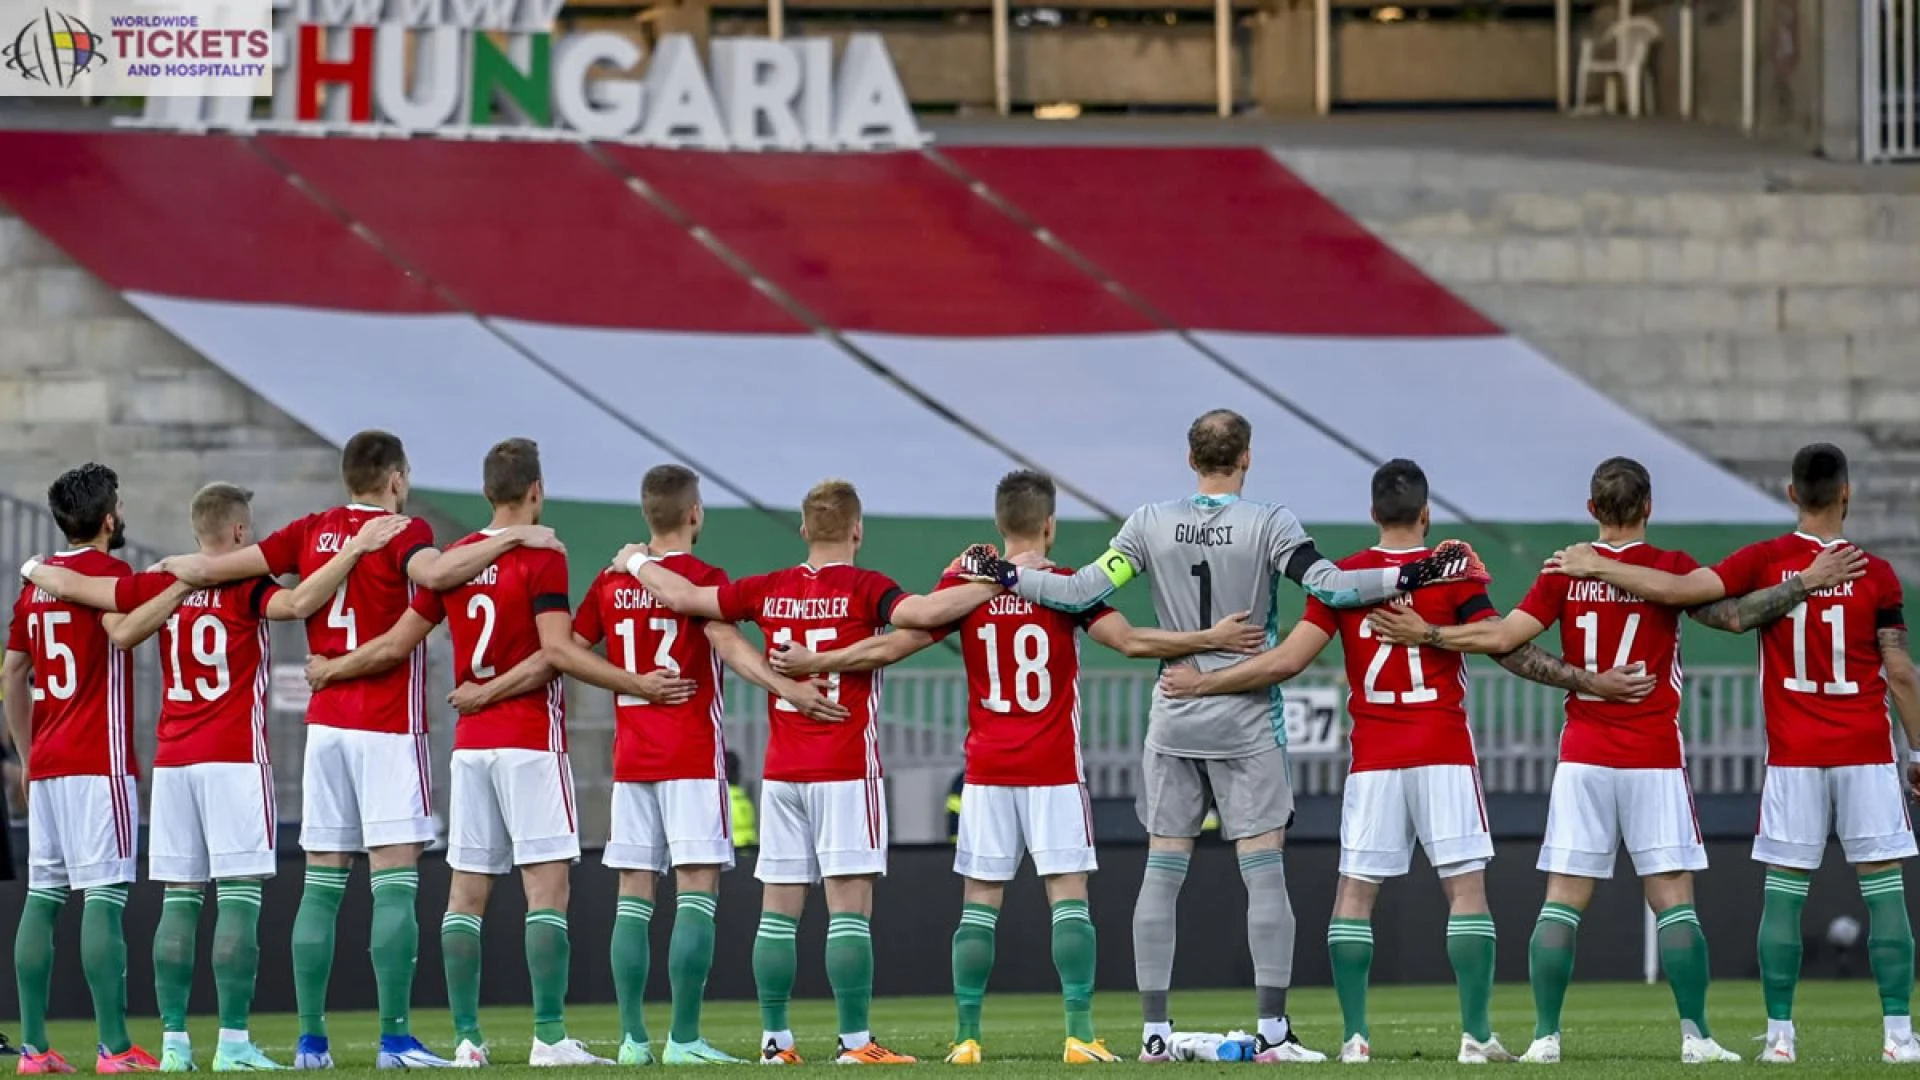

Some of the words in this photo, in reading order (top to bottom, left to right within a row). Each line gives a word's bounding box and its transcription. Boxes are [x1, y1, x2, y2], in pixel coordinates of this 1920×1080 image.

[316, 532, 352, 553] SZAL
[1106, 555, 1125, 573] C
[1175, 522, 1233, 547] GULÁCSI
[466, 564, 498, 585] NG
[614, 588, 667, 609] SCHAF
[762, 596, 848, 619] KLEINHEISLER
[1191, 560, 1212, 631] 1
[327, 576, 358, 651] 4
[467, 593, 496, 679] 2
[1784, 601, 1859, 695] 11
[166, 613, 231, 702] 19
[615, 617, 681, 707] 13
[976, 623, 1052, 713] 18
[1359, 617, 1438, 704] 21
[1575, 610, 1648, 702] 14
